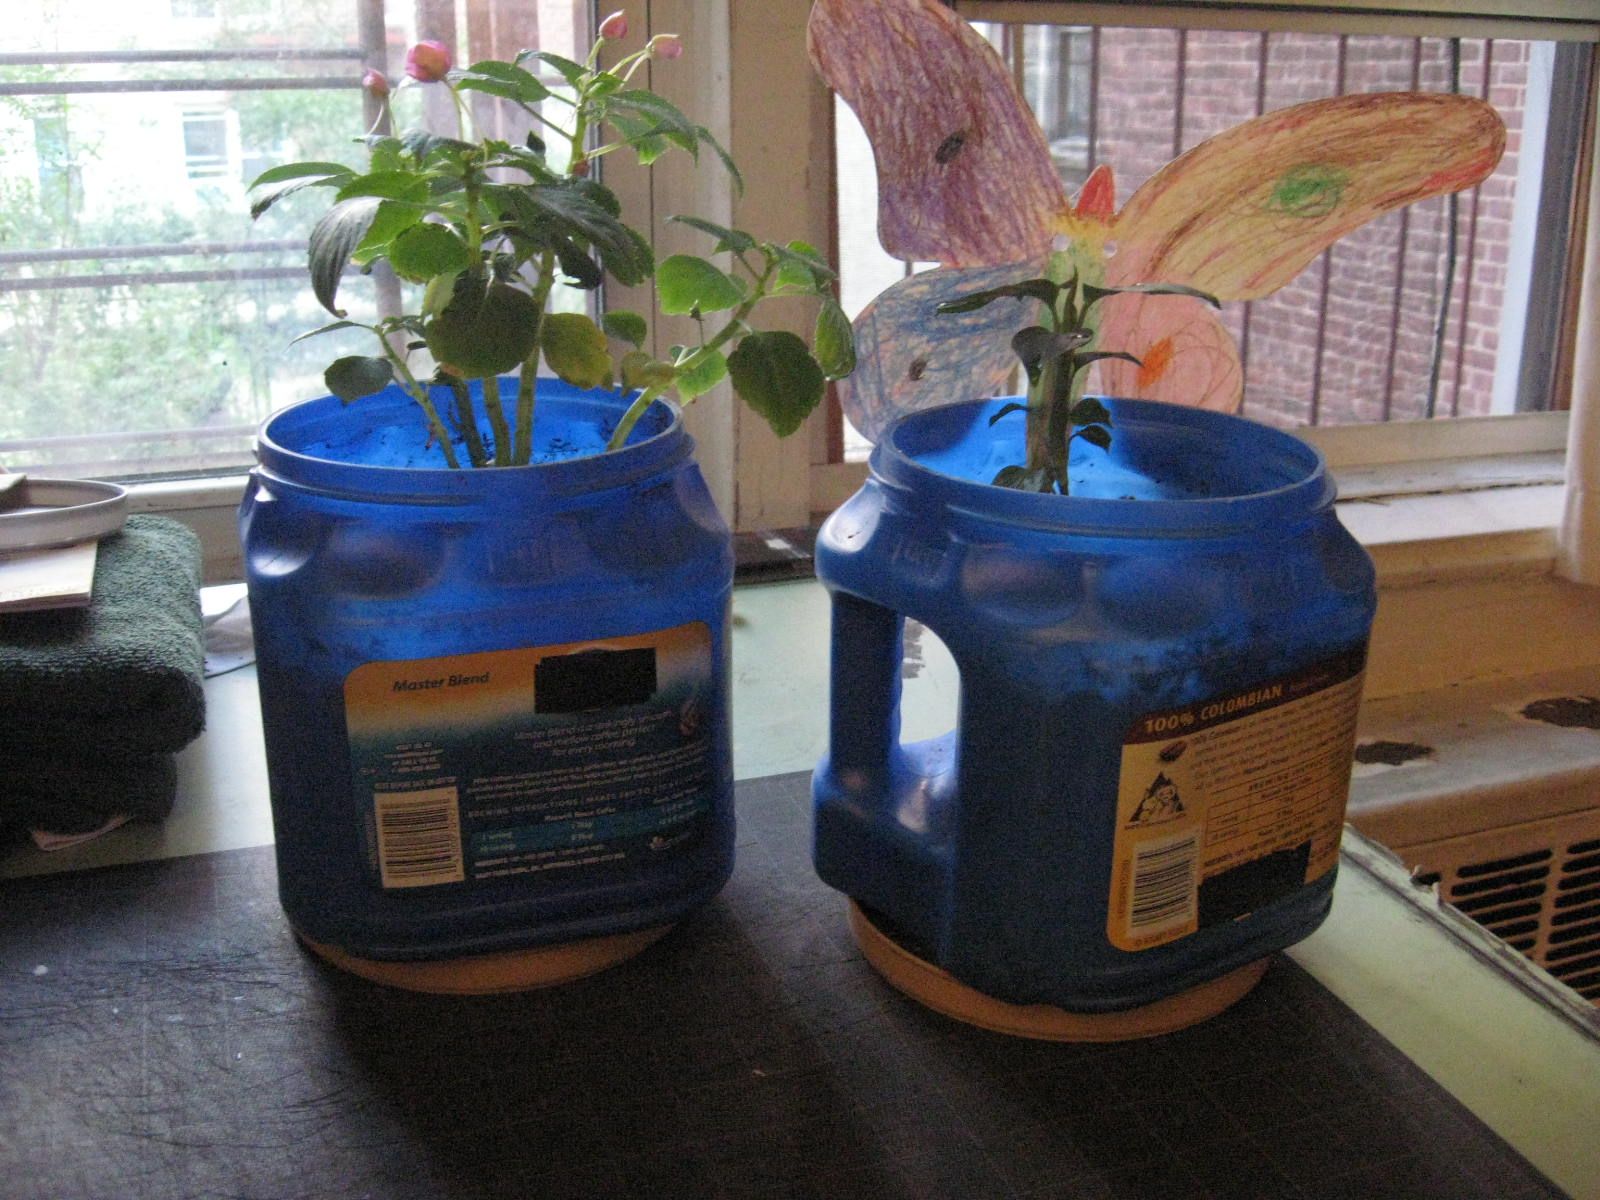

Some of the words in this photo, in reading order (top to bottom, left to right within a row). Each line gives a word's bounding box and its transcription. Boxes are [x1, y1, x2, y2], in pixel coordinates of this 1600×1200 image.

[393, 678, 444, 692] Master
[448, 671, 490, 687] Blend
[1144, 712, 1195, 734] 100%
[1200, 684, 1283, 720] COLOMBIAN
